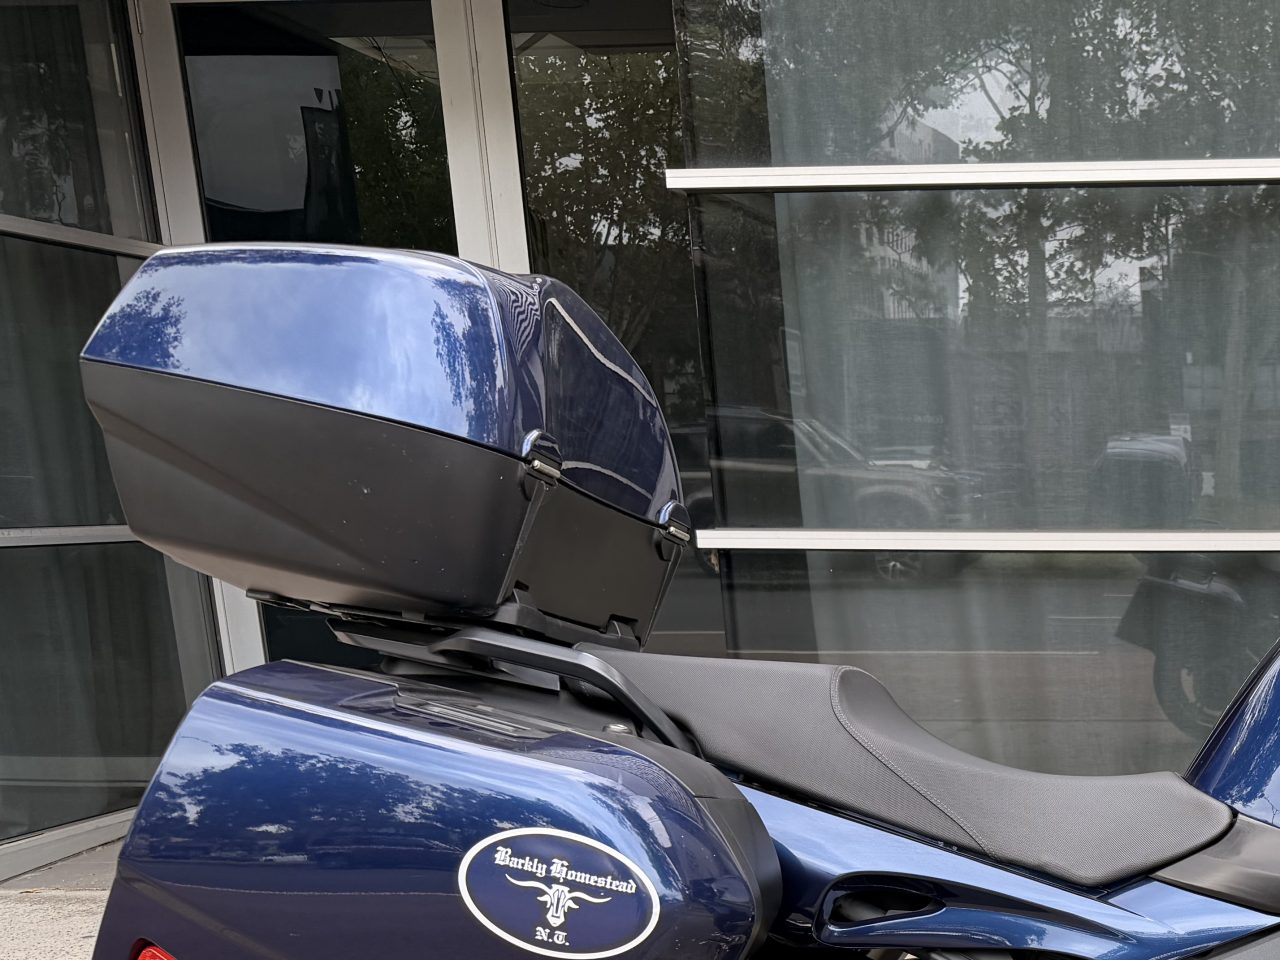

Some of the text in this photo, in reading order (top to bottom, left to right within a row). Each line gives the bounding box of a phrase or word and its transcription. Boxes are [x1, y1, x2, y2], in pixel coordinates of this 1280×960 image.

[494, 846, 637, 894] Barkly Homestead
[535, 926, 570, 946] N.T.
